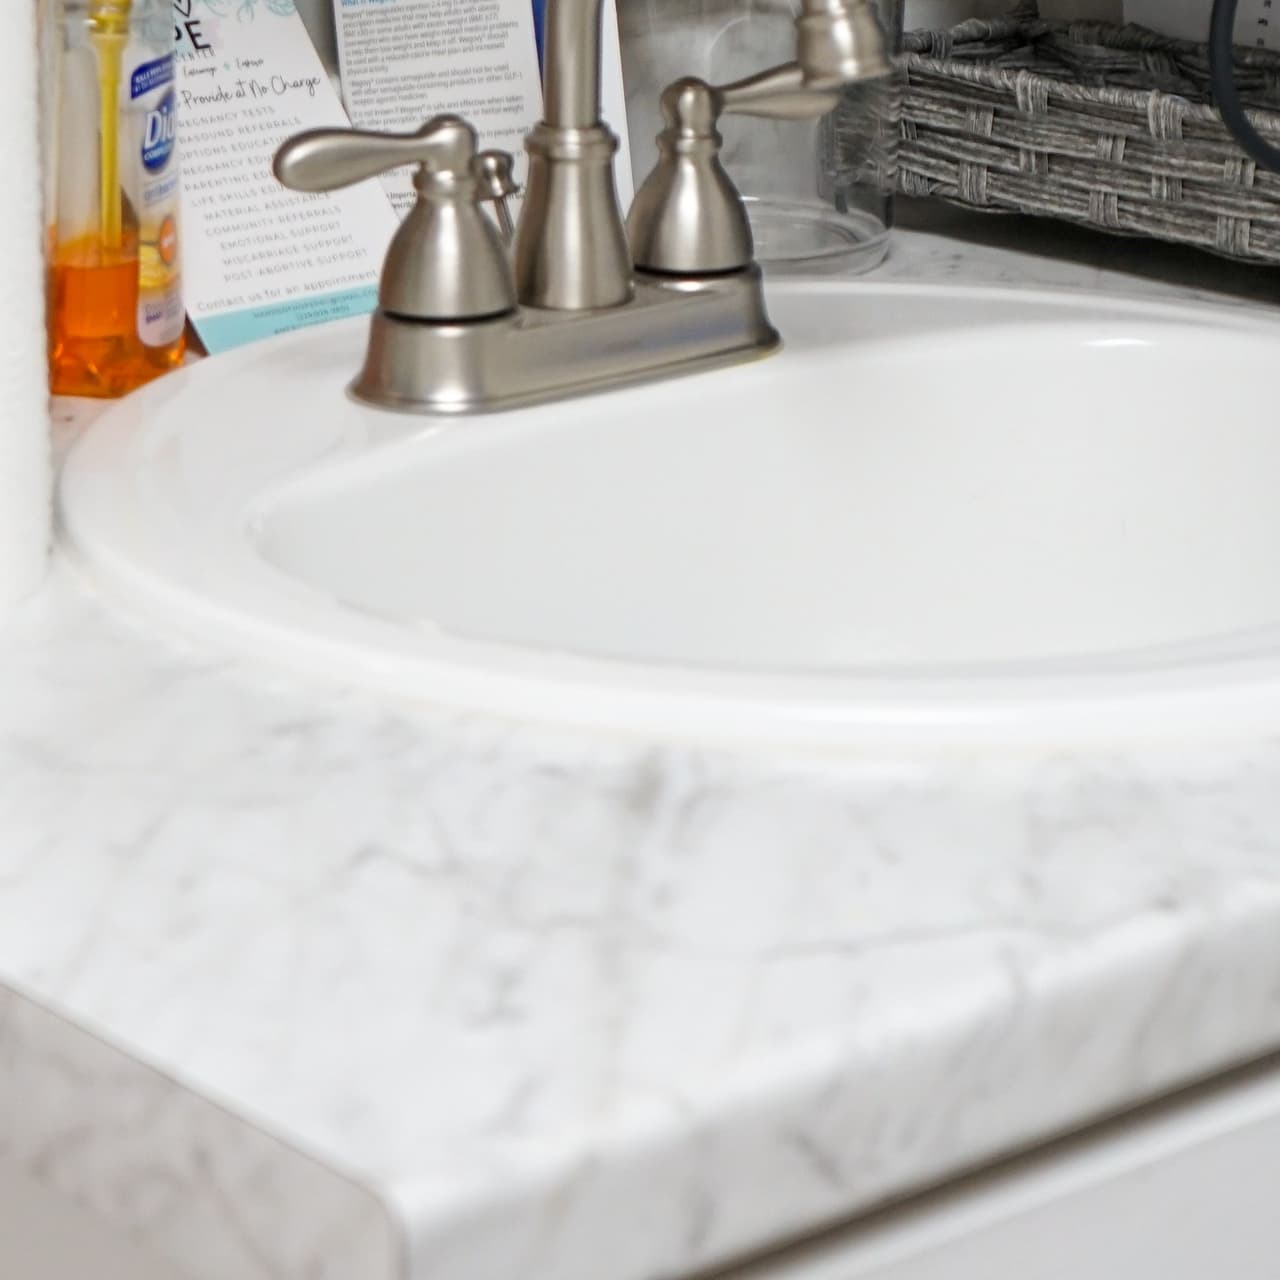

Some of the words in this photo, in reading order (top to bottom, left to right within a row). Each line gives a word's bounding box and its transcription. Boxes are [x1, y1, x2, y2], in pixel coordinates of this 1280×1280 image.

[181, 85, 233, 109] Provide
[235, 80, 247, 98] at
[249, 79, 269, 99] No
[271, 75, 321, 96] Charge
[144, 104, 175, 149] Dia
[242, 105, 276, 118] TESTS
[184, 174, 251, 193] PARENTING
[203, 205, 262, 222] MATERIAL
[205, 218, 275, 238] COMMUNITY
[278, 204, 343, 224] REFERRALS
[220, 232, 288, 251] EMOTIONAL
[289, 220, 342, 238] SUPPORT
[223, 245, 300, 267] MISCARRIAGE
[302, 234, 354, 252] SUPPORT
[317, 247, 369, 265] SUPPORT
[197, 295, 245, 312] Contact
[248, 292, 263, 303] us
[264, 288, 282, 299] for
[285, 286, 299, 296] an
[303, 270, 378, 291] appointment
